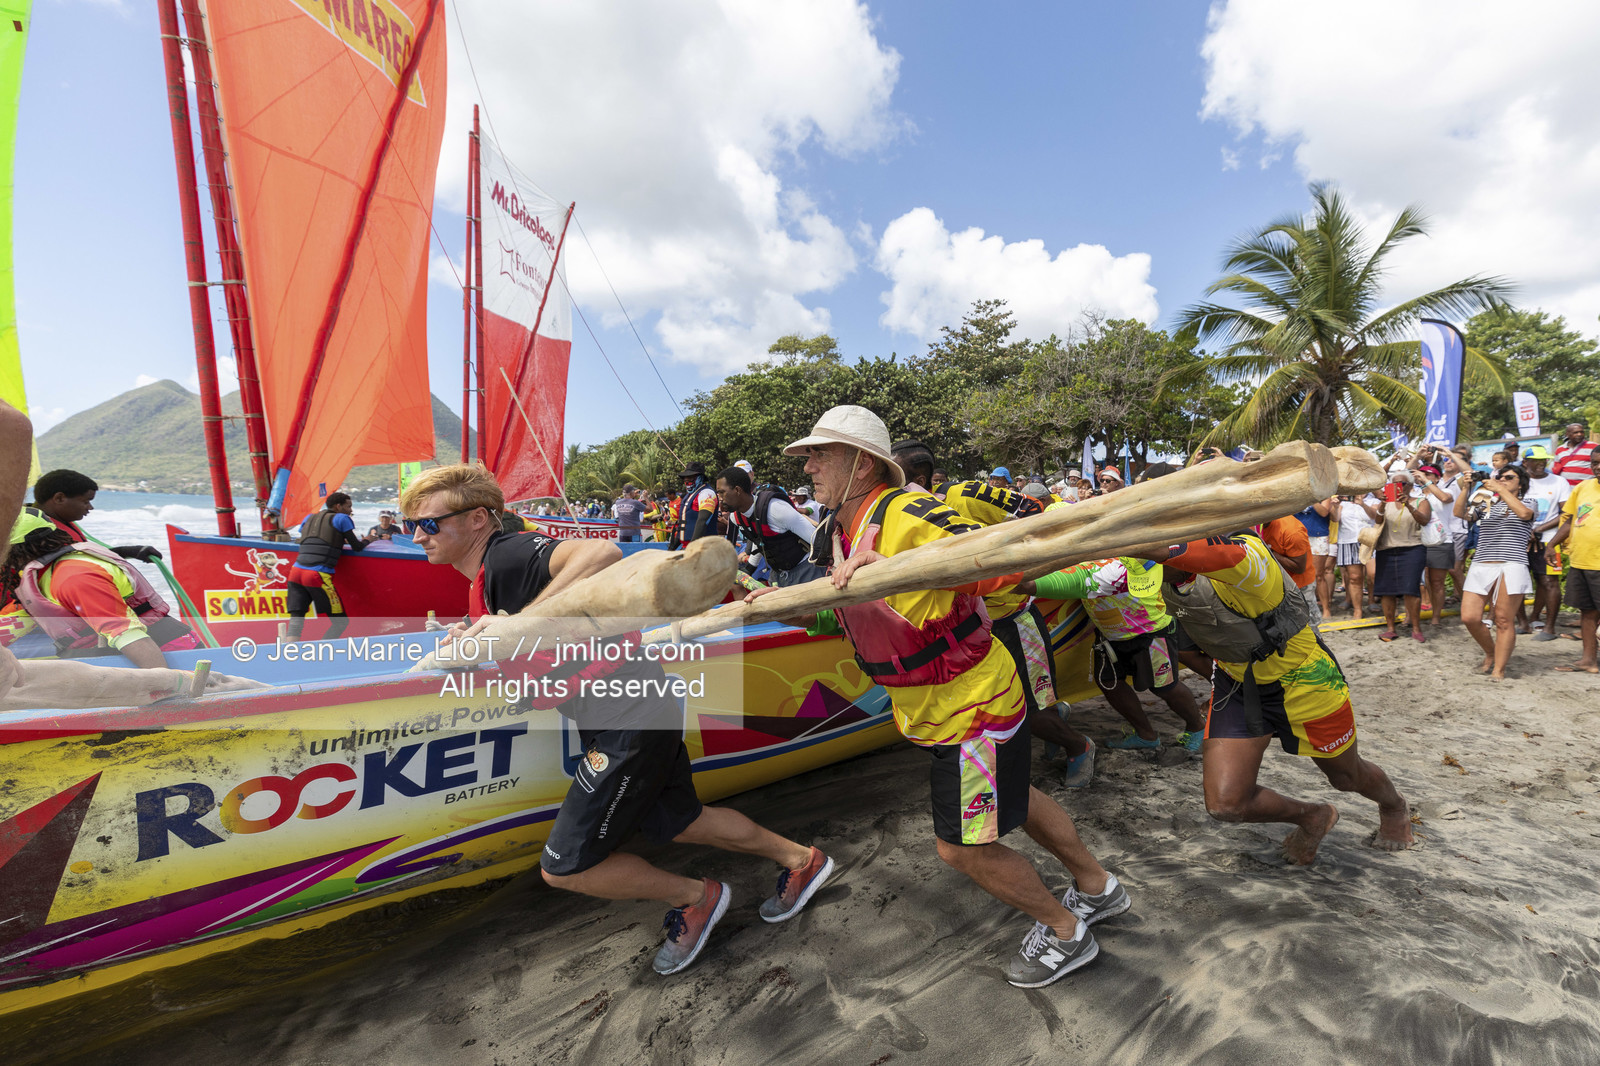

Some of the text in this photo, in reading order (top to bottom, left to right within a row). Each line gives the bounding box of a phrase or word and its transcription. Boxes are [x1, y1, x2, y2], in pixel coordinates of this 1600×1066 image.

[310, 702, 520, 756] unlimited Powe
[135, 720, 528, 862] ROCKET
[444, 777, 520, 804] BATTERY
[1039, 947, 1065, 971] N
